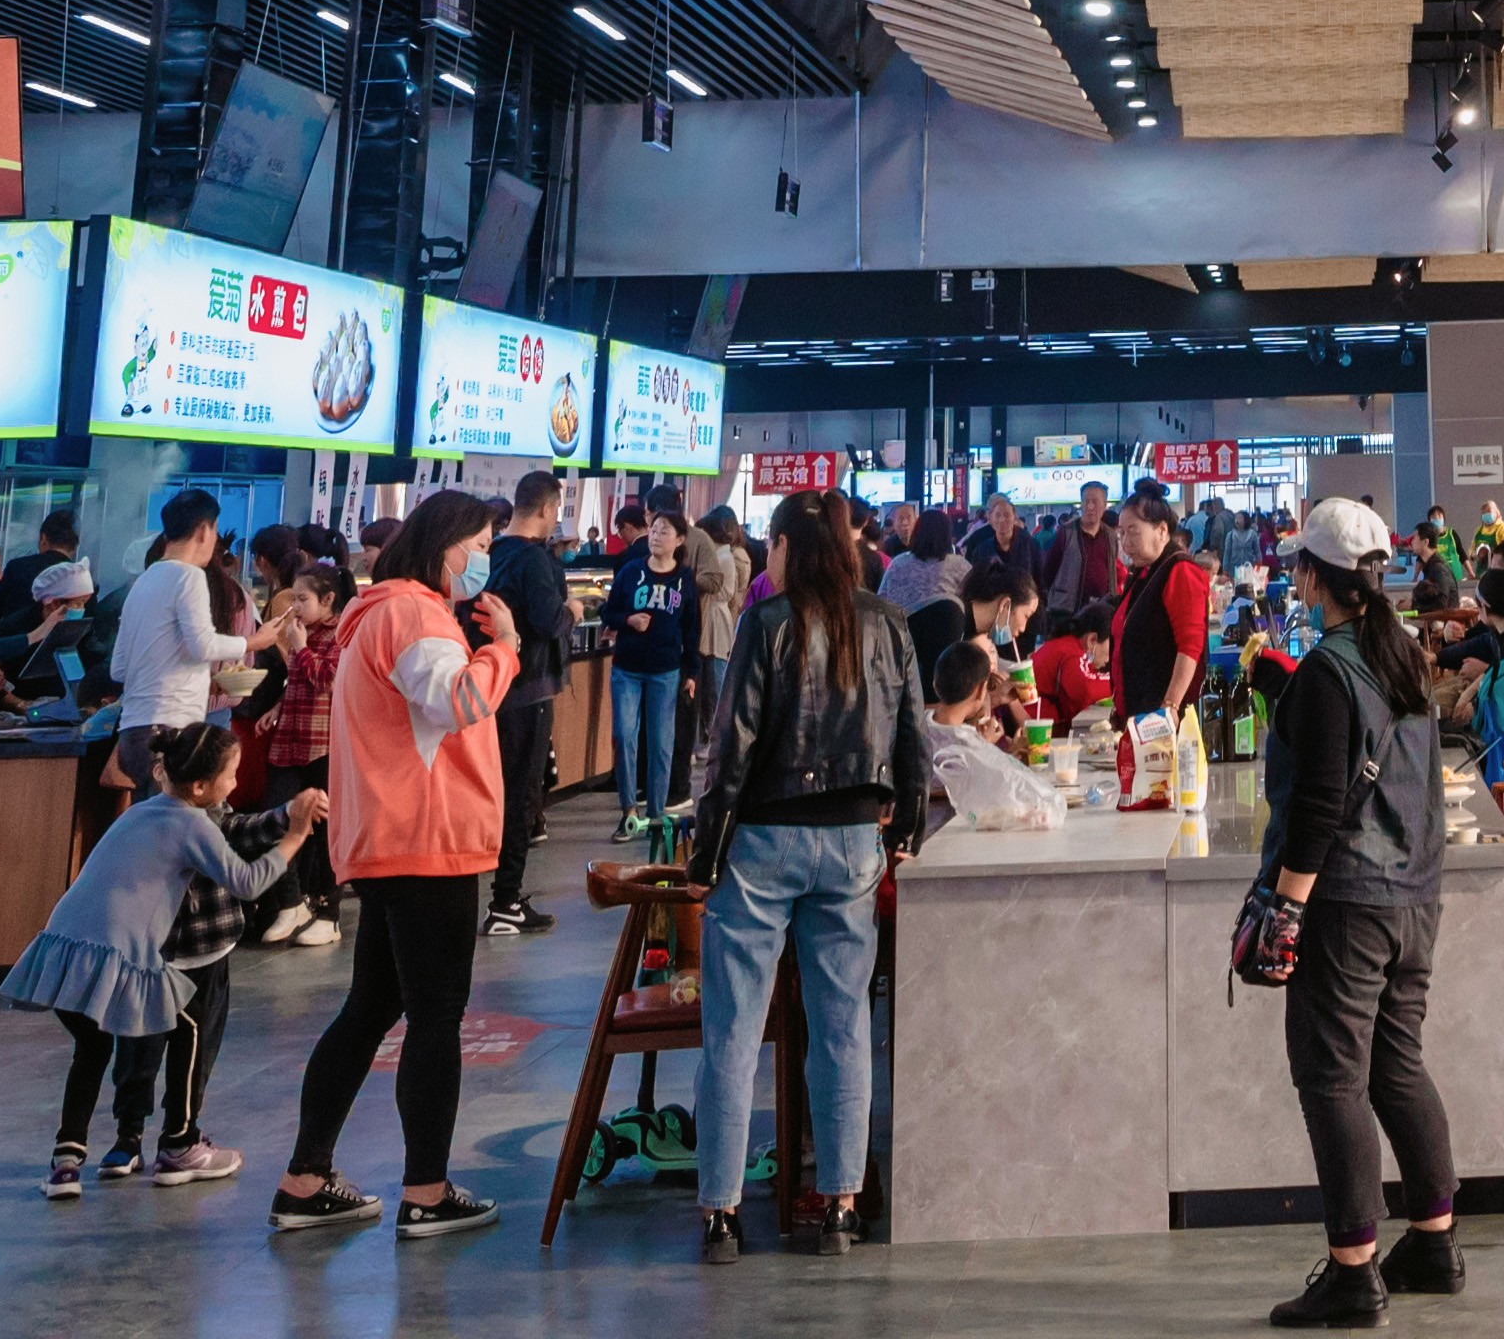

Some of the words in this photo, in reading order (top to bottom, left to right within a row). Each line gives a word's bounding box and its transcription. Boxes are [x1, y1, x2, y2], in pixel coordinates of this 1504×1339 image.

[207, 267, 245, 324] 爱菊
[249, 281, 307, 333] 水煎包
[761, 454, 806, 467] 健康产品
[1162, 455, 1212, 475] 展示馆
[1456, 454, 1501, 467] 餐具收集处
[758, 466, 809, 485] 展示馆
[634, 584, 682, 615] GAP
